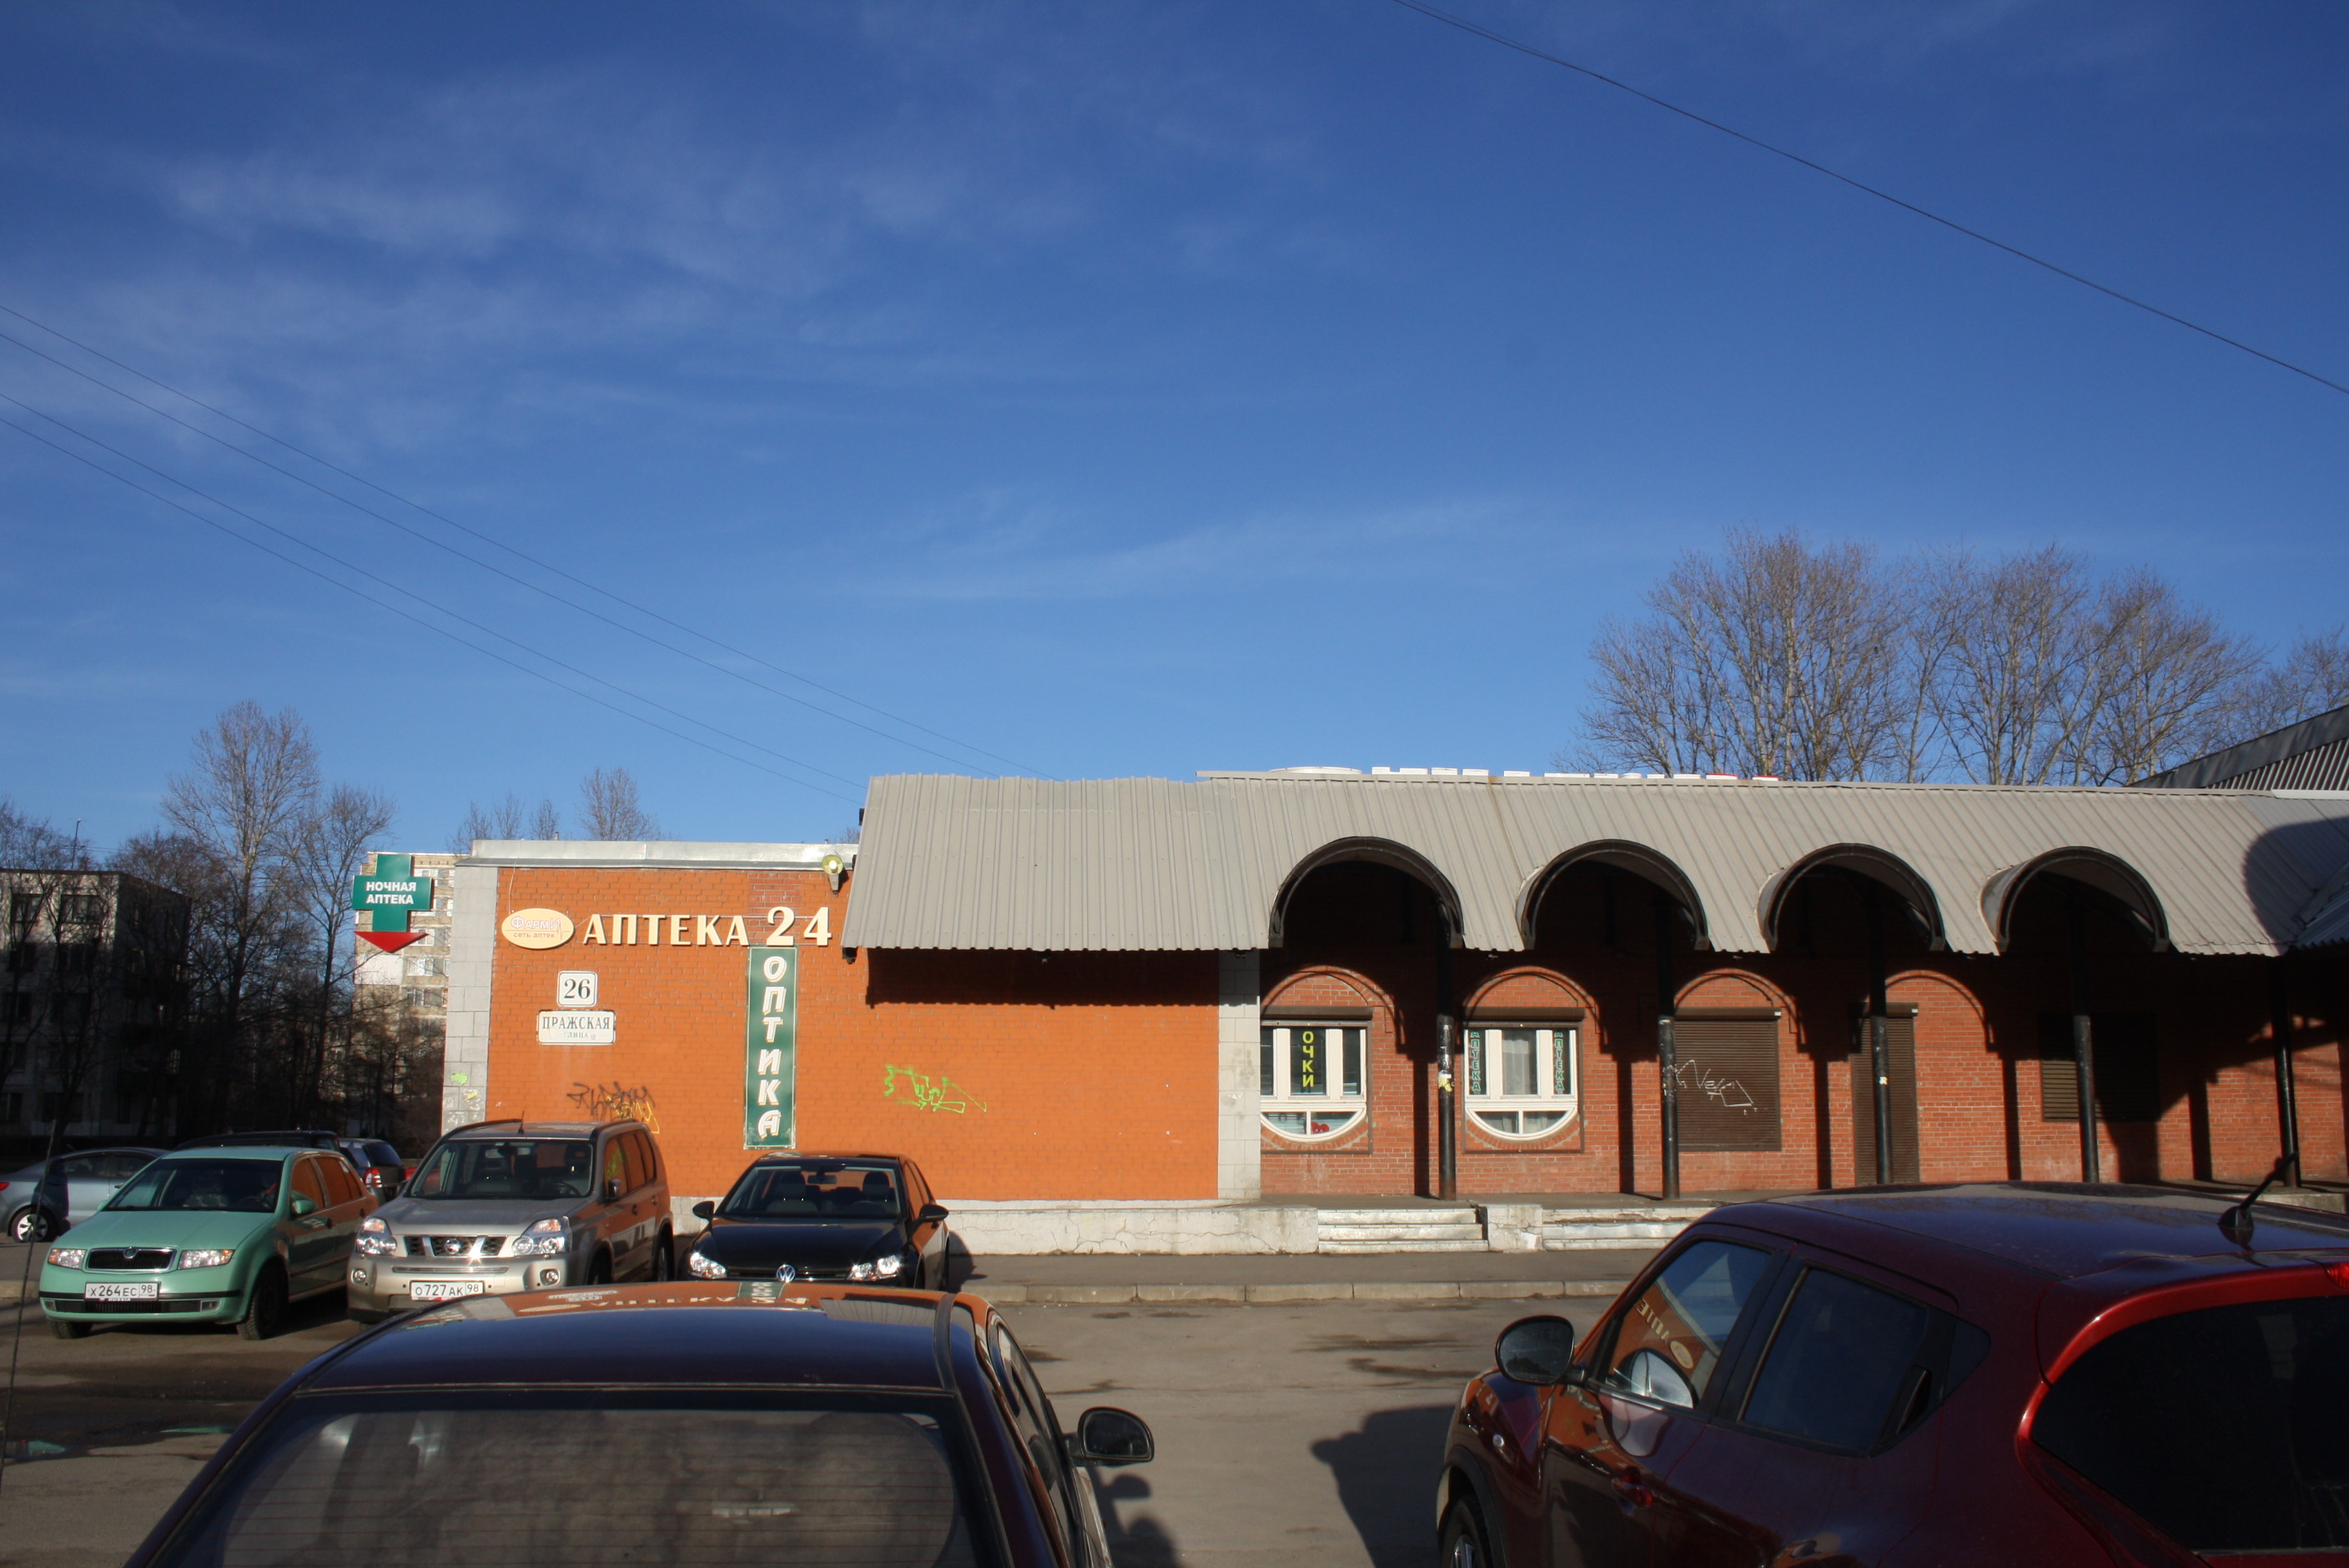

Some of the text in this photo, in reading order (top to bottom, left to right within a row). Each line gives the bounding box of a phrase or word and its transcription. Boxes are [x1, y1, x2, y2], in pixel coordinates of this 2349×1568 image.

[365, 881, 416, 892] НОЧНАЯ
[365, 893, 415, 905] АПТЕКА
[583, 906, 832, 947] АПТЕКА 24
[563, 978, 591, 1000] 26
[541, 1016, 611, 1030] ПРАЖСКАЯ
[561, 1031, 589, 1039] ЛИЦА
[757, 956, 787, 1139] ОПТИКА
[1302, 1030, 1315, 1088] ОЧКИ
[1471, 1031, 1481, 1092] АПТЕКА
